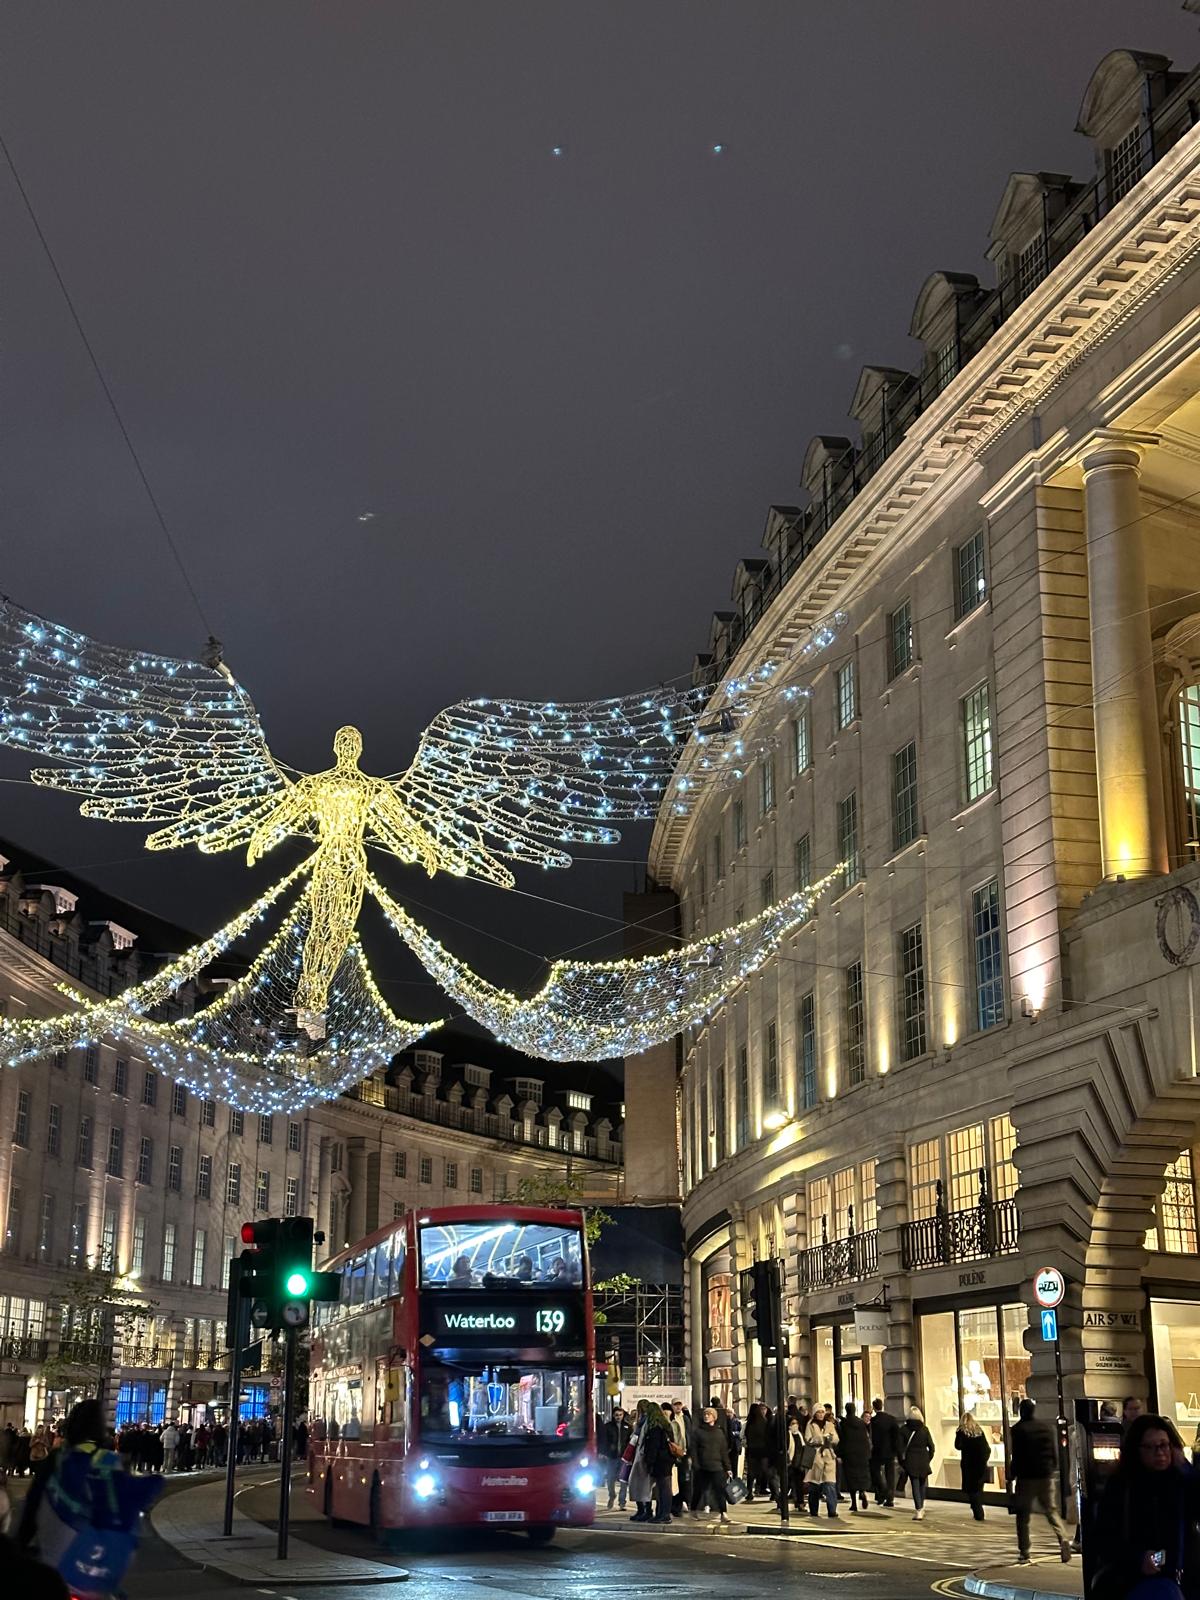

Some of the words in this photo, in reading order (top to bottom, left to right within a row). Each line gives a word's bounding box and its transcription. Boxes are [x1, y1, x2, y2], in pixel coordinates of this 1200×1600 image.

[959, 1269, 986, 1287] POLÈNE
[444, 1313, 515, 1328] Waterloo
[536, 1310, 565, 1332] 139
[1085, 1313, 1105, 1325] AIR
